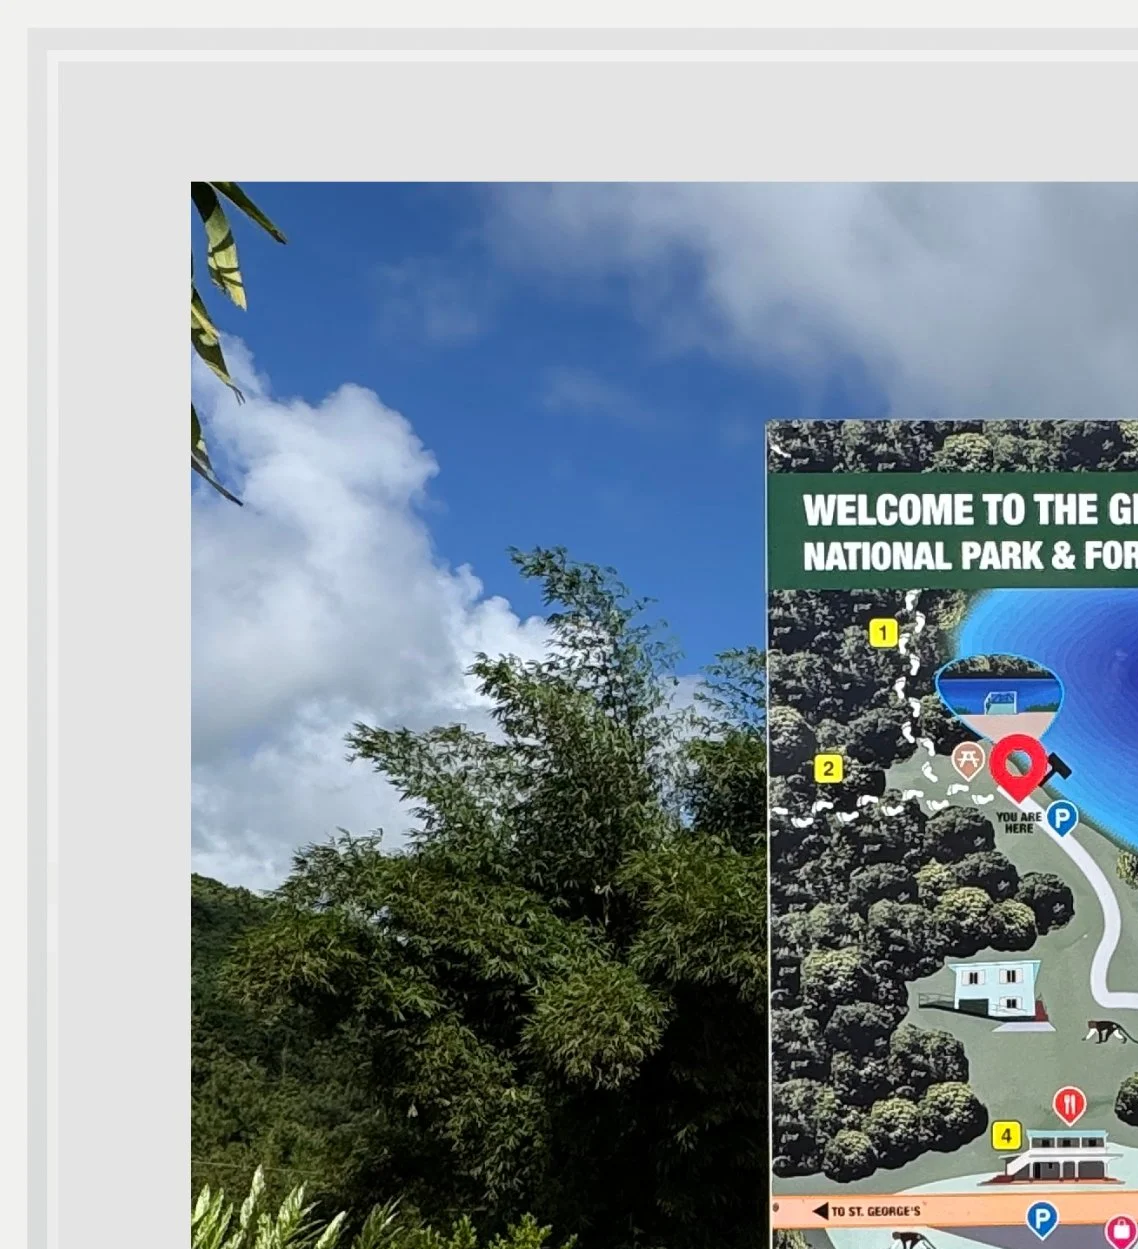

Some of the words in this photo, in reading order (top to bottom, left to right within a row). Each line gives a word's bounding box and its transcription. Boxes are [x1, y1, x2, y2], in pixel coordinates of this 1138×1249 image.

[803, 493, 974, 526] WELCOME
[982, 493, 1025, 526] TO
[1033, 493, 1098, 525] THE
[804, 541, 953, 571] NATIONAL
[961, 540, 1044, 570] PARK
[1051, 540, 1076, 570] &
[879, 624, 886, 641] 1
[823, 760, 834, 776] 2
[996, 811, 1018, 822] YOU
[1020, 811, 1042, 822] ARE
[1055, 808, 1070, 828] P
[1005, 823, 1034, 834] HERE
[1001, 1127, 1012, 1144] 4
[832, 1206, 845, 1217] TO
[849, 1206, 864, 1217] ST.
[867, 1206, 921, 1217] GEORGE'S
[1035, 1208, 1050, 1229] P
